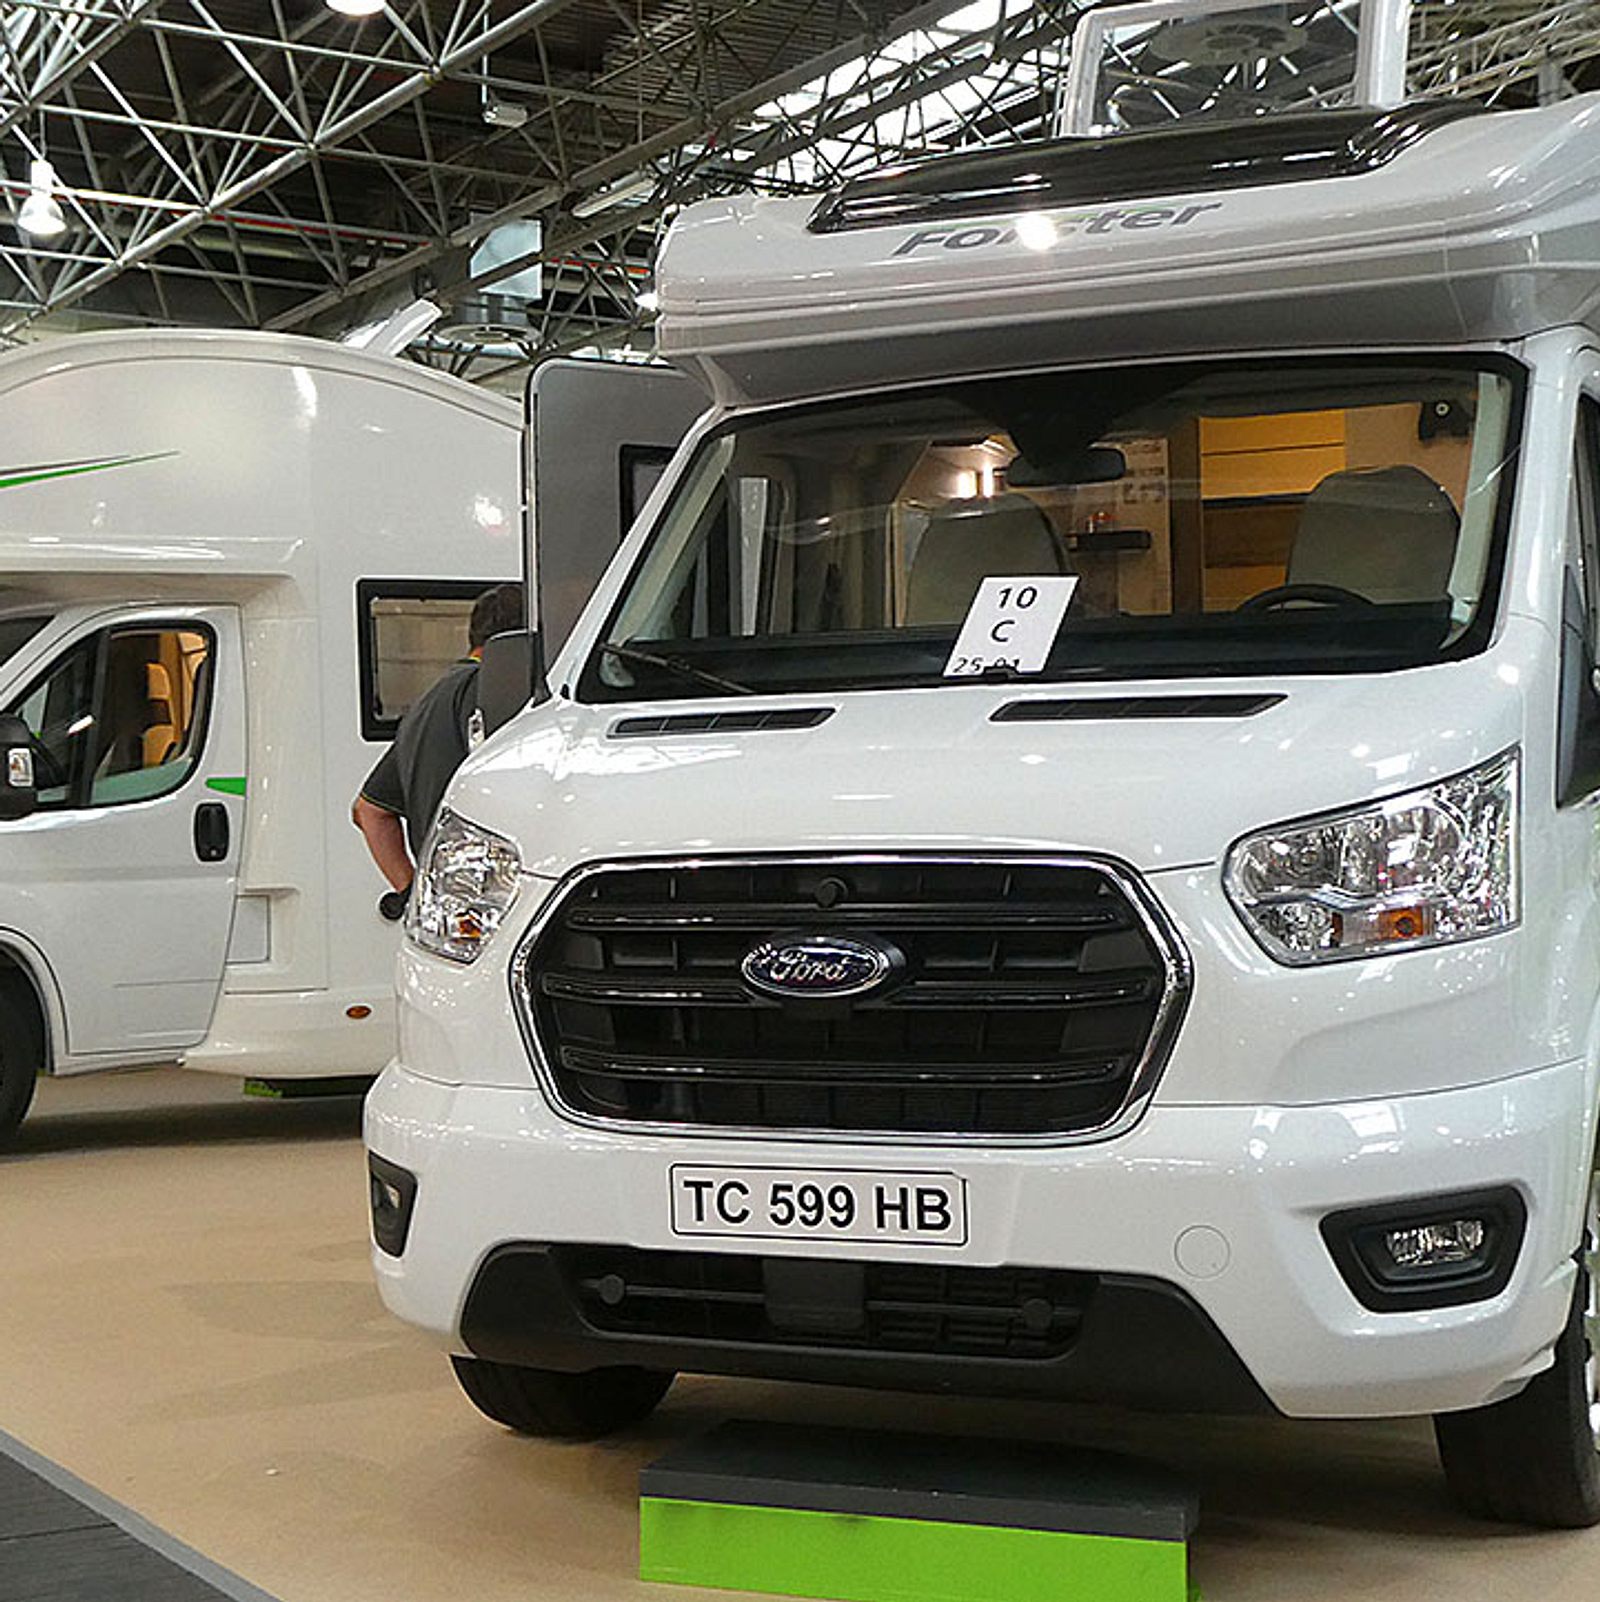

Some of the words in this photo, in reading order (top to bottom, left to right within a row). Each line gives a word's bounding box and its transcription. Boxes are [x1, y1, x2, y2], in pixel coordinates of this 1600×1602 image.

[999, 586, 1038, 609] 10
[991, 620, 1015, 642] C
[757, 948, 868, 983] Ford
[683, 1180, 750, 1224] TC
[769, 1183, 856, 1228] 599
[875, 1185, 952, 1231] HB
